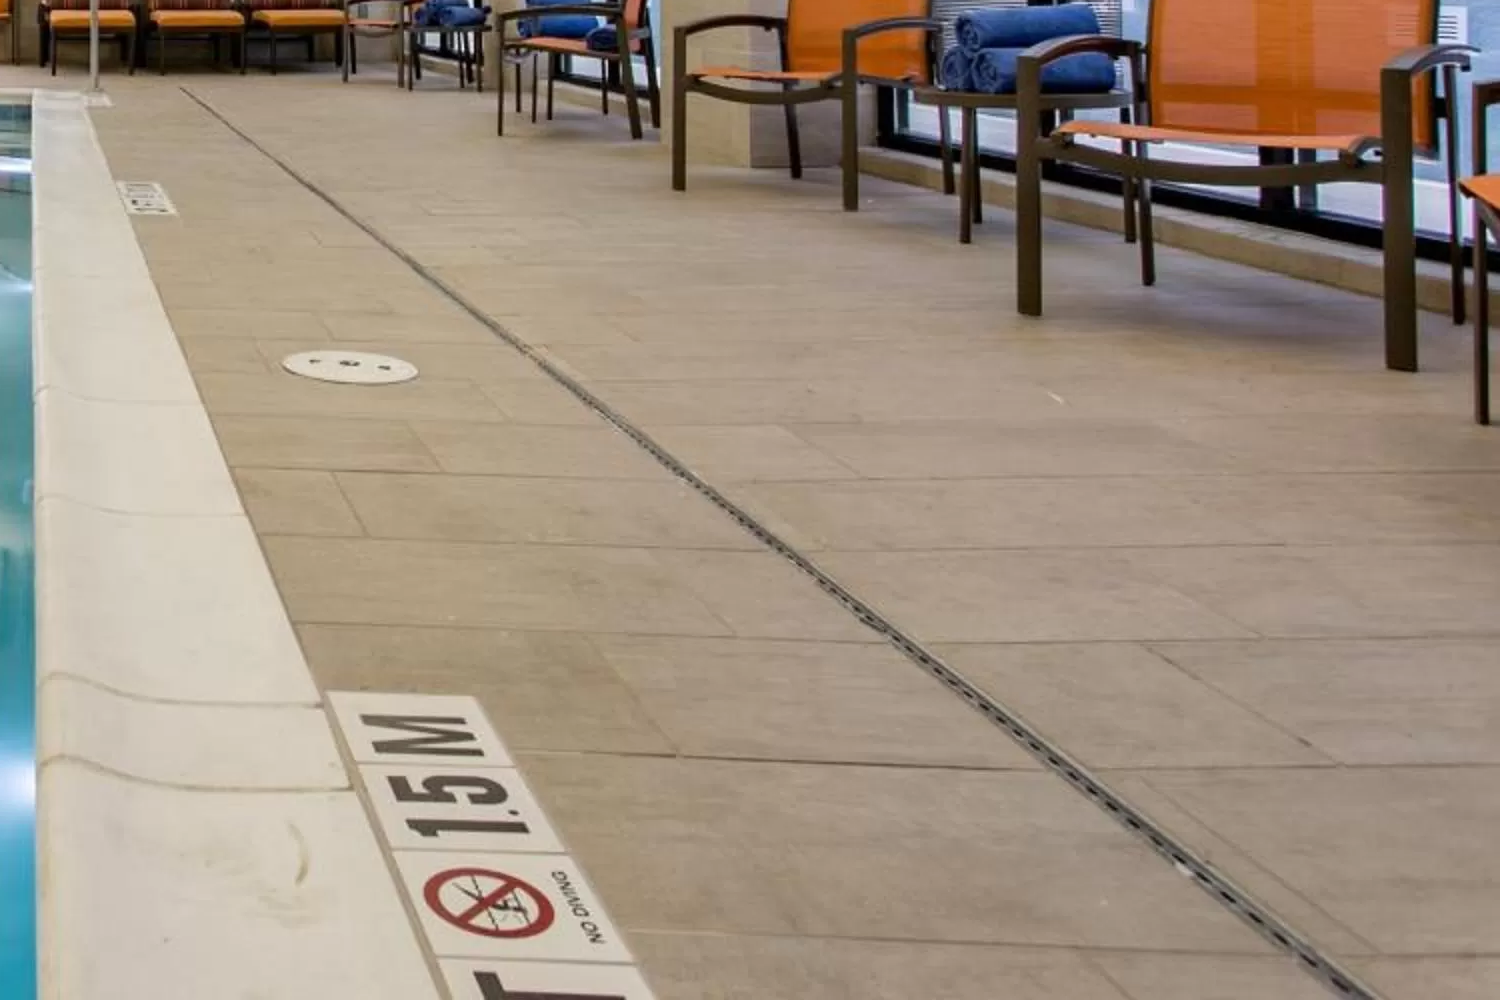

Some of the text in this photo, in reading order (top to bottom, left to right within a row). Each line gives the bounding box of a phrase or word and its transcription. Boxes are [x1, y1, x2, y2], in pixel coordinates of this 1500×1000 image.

[359, 713, 531, 838] 1.5 M
[551, 869, 605, 946] NO DIVING
